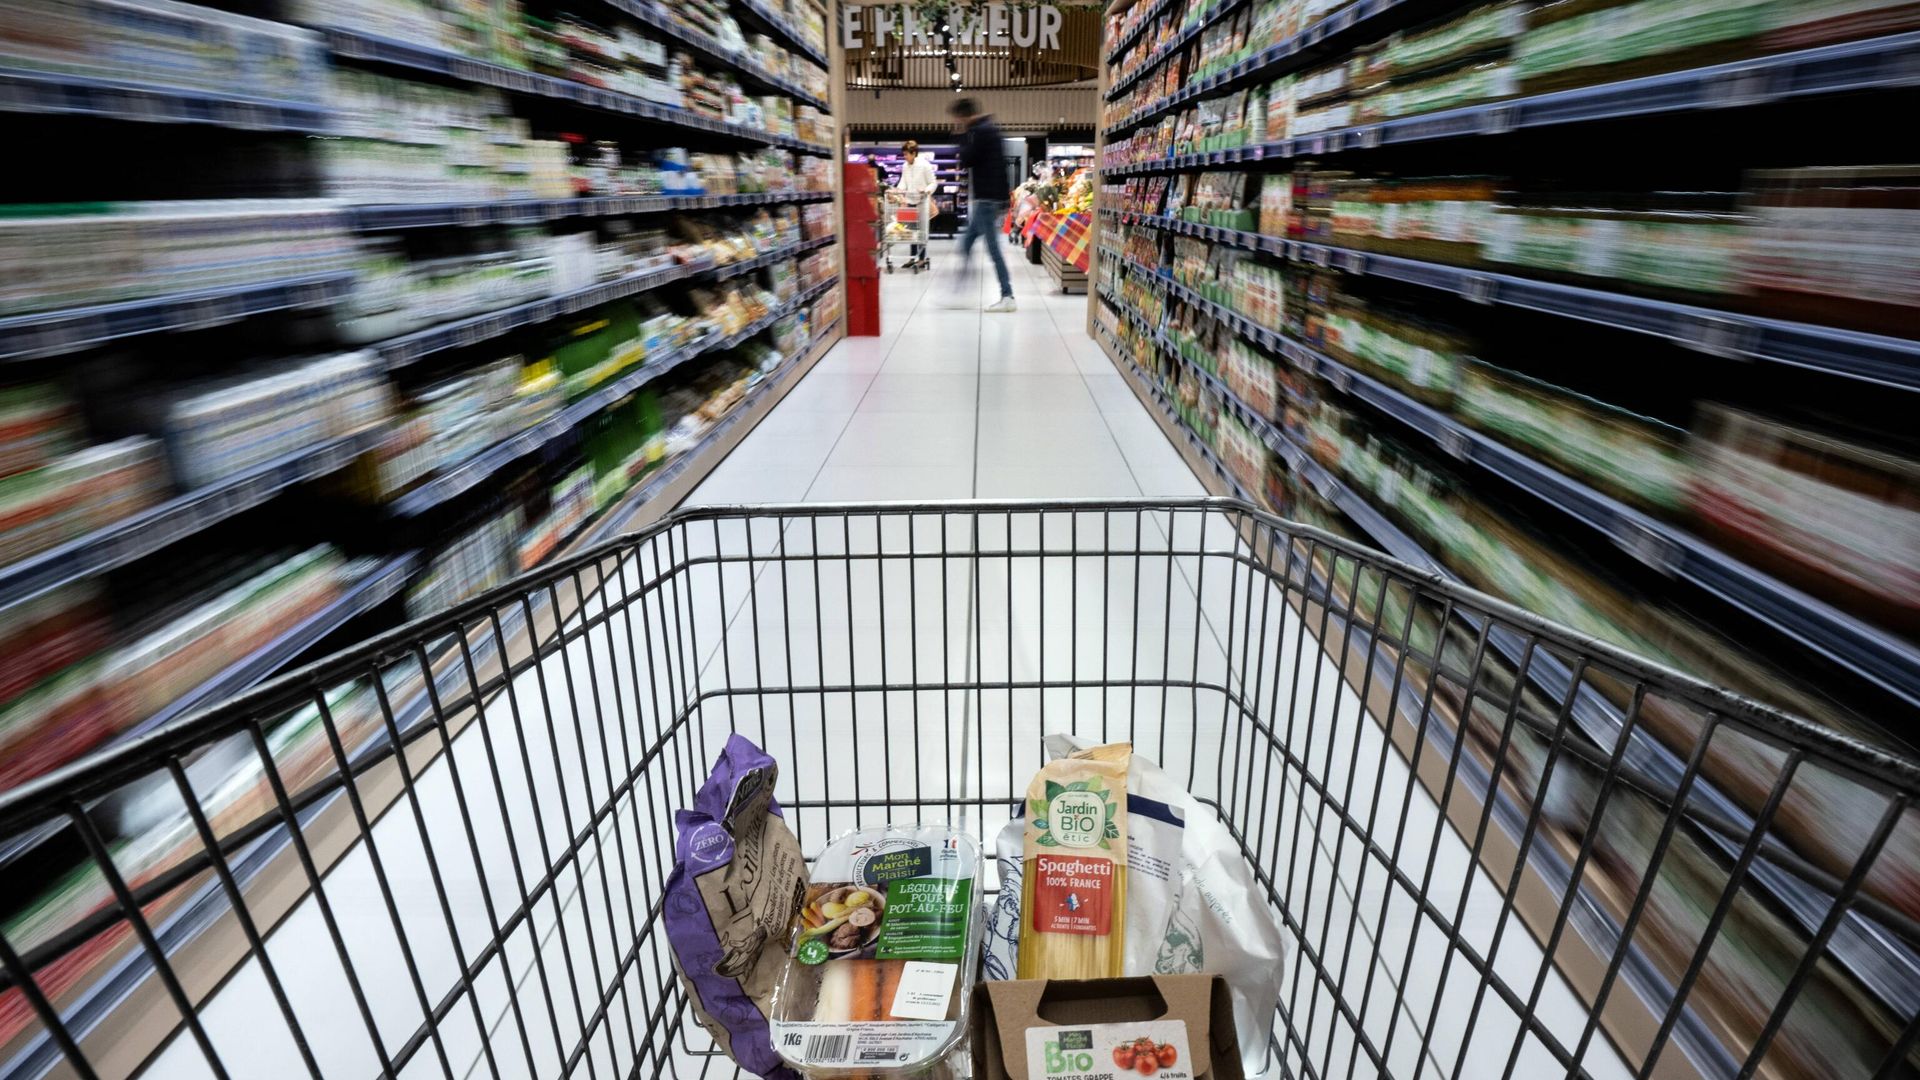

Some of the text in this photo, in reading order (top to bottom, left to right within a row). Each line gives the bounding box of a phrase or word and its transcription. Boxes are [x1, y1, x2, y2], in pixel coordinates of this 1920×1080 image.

[875, 3, 1062, 50] PRMEUR
[1057, 800, 1097, 815] Jardin
[1061, 816, 1095, 832] BiO
[695, 834, 724, 851] ZERO
[884, 853, 909, 863] Mon
[872, 858, 921, 872] Marché
[1038, 858, 1111, 876] Spaghetti
[877, 869, 917, 881] Plaisir
[1046, 877, 1101, 889] 100% FRANCE
[911, 894, 944, 904] POUR
[888, 904, 964, 914] POT-AU-FEU
[807, 947, 817, 959] 4
[783, 1033, 802, 1046] 1KG
[1045, 1041, 1094, 1073] Bio
